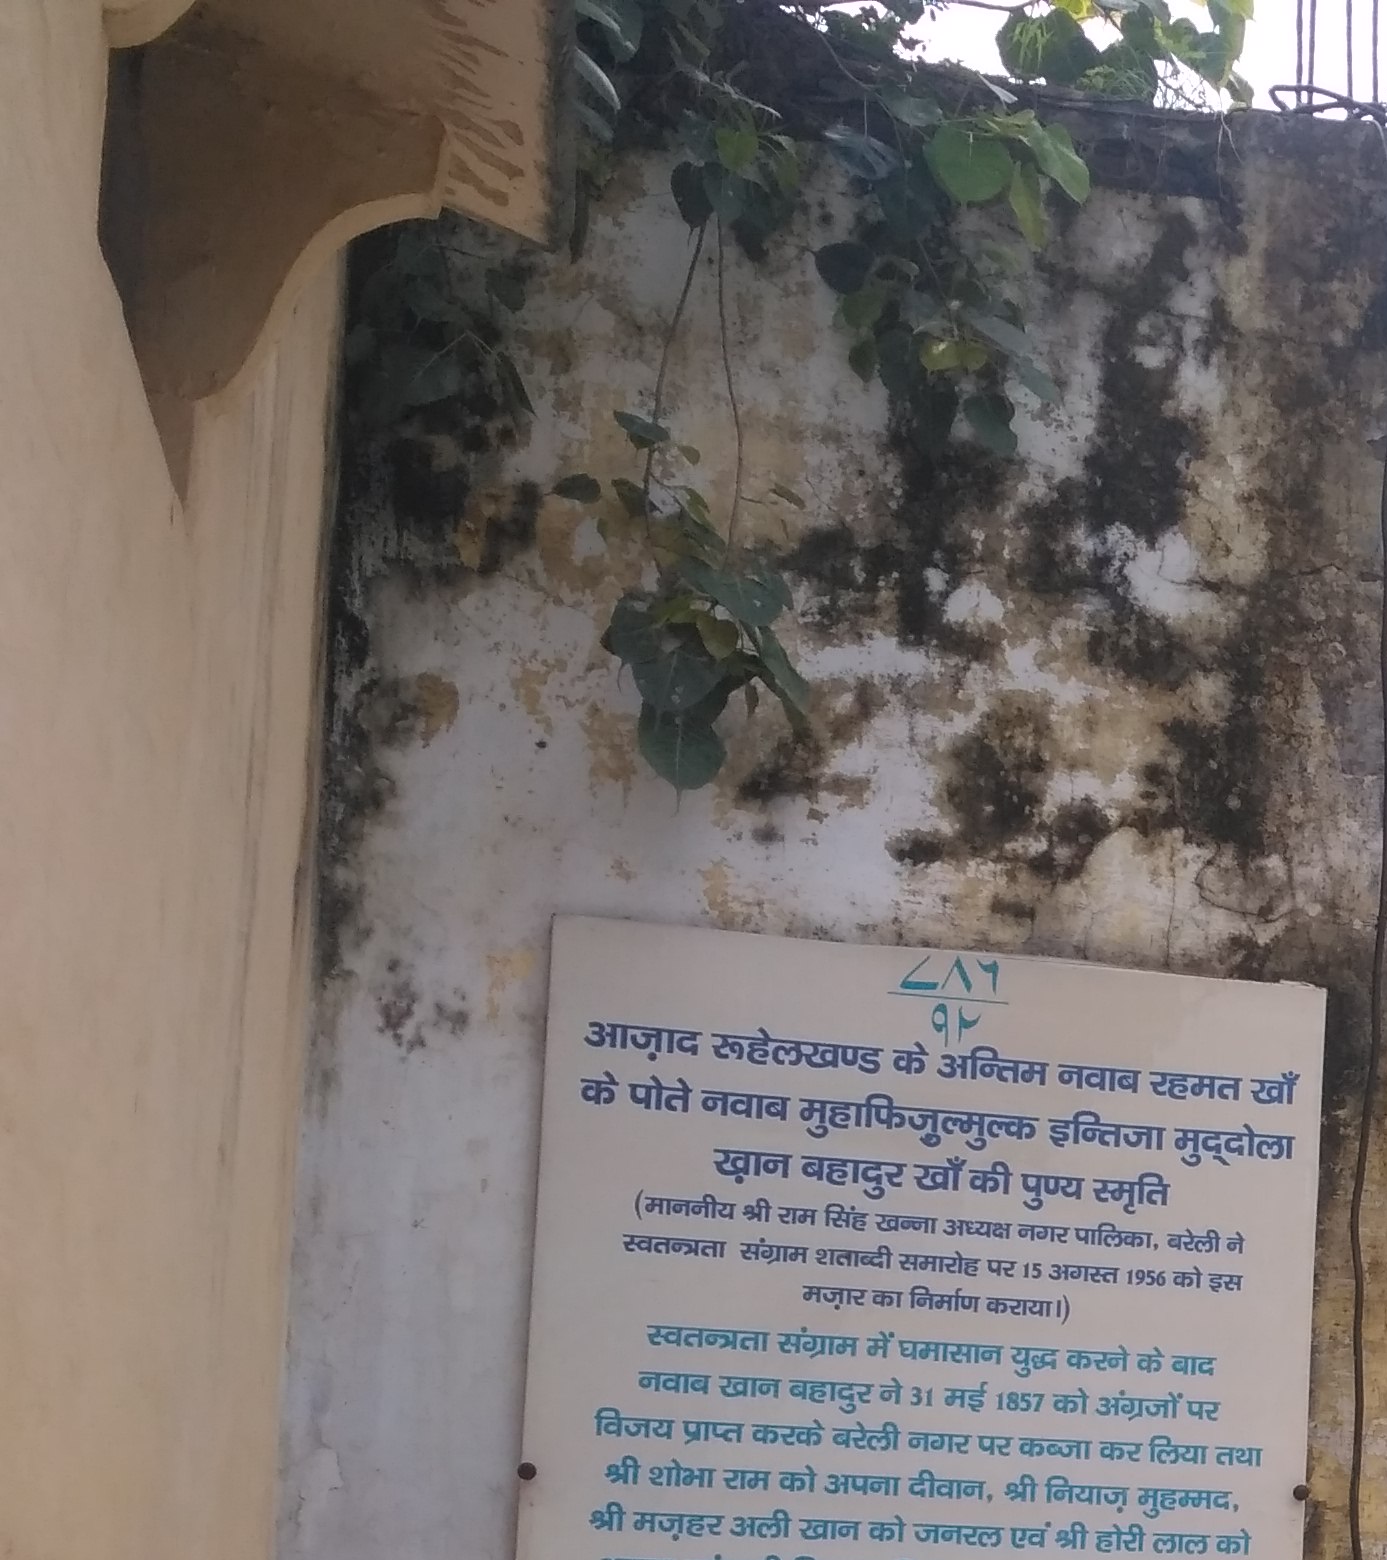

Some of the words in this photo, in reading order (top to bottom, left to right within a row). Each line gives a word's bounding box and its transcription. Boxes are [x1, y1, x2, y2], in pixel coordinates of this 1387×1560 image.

[579, 1069, 620, 1105] के
[626, 1073, 693, 1113] पोते
[699, 1088, 792, 1122] नवाब
[582, 1020, 704, 1062] आज़ाद
[709, 1025, 885, 1075] रूहेलखण्ड
[891, 1040, 930, 1075] के
[935, 1044, 1050, 1086] अन्तिम
[1056, 1062, 1142, 1094] नवाब
[1147, 1070, 1243, 1101] रहमत
[1249, 1069, 1301, 1105] खाँ
[712, 1147, 794, 1185] ख़ान
[799, 1154, 908, 1201] बहादुर
[911, 1156, 968, 1192] खाँ
[967, 1159, 1014, 1195] की
[1019, 1172, 1086, 1211] पुण्य
[1091, 1170, 1171, 1215] स्मृति
[633, 1188, 737, 1221] (माननीय
[740, 1196, 773, 1223] श्री
[776, 1205, 819, 1226] राम
[822, 1201, 870, 1232] सिंह
[873, 1212, 939, 1235] खन्ना
[941, 1218, 1013, 1240] अध्यक्ष
[1016, 1222, 1070, 1244] नगर
[1073, 1221, 1159, 1251] पालिका,
[1165, 1226, 1222, 1254] बरेली
[1225, 1230, 1246, 1255] ने
[801, 1284, 869, 1311] मज़ार
[870, 1288, 905, 1309] का
[907, 1284, 982, 1313] निर्माण
[645, 1323, 770, 1352] स्वतन्त्रता
[776, 1325, 860, 1359] संग्राम
[865, 1330, 895, 1359] में
[897, 1338, 1004, 1365] घमासान
[1009, 1345, 1061, 1378] युद्ध
[1065, 1343, 1131, 1372] करने
[1135, 1345, 1165, 1374] के
[1170, 1354, 1217, 1376] बाद
[603, 1453, 642, 1486] श्री
[647, 1457, 717, 1488] शोभा
[722, 1468, 772, 1491] राम
[777, 1463, 818, 1493] को
[823, 1472, 902, 1497] अपना
[907, 1468, 993, 1503] दीवान,
[1003, 1472, 1039, 1503] श्री
[1043, 1474, 1130, 1514] नियाज़
[1136, 1486, 1239, 1520] मुहम्मद,
